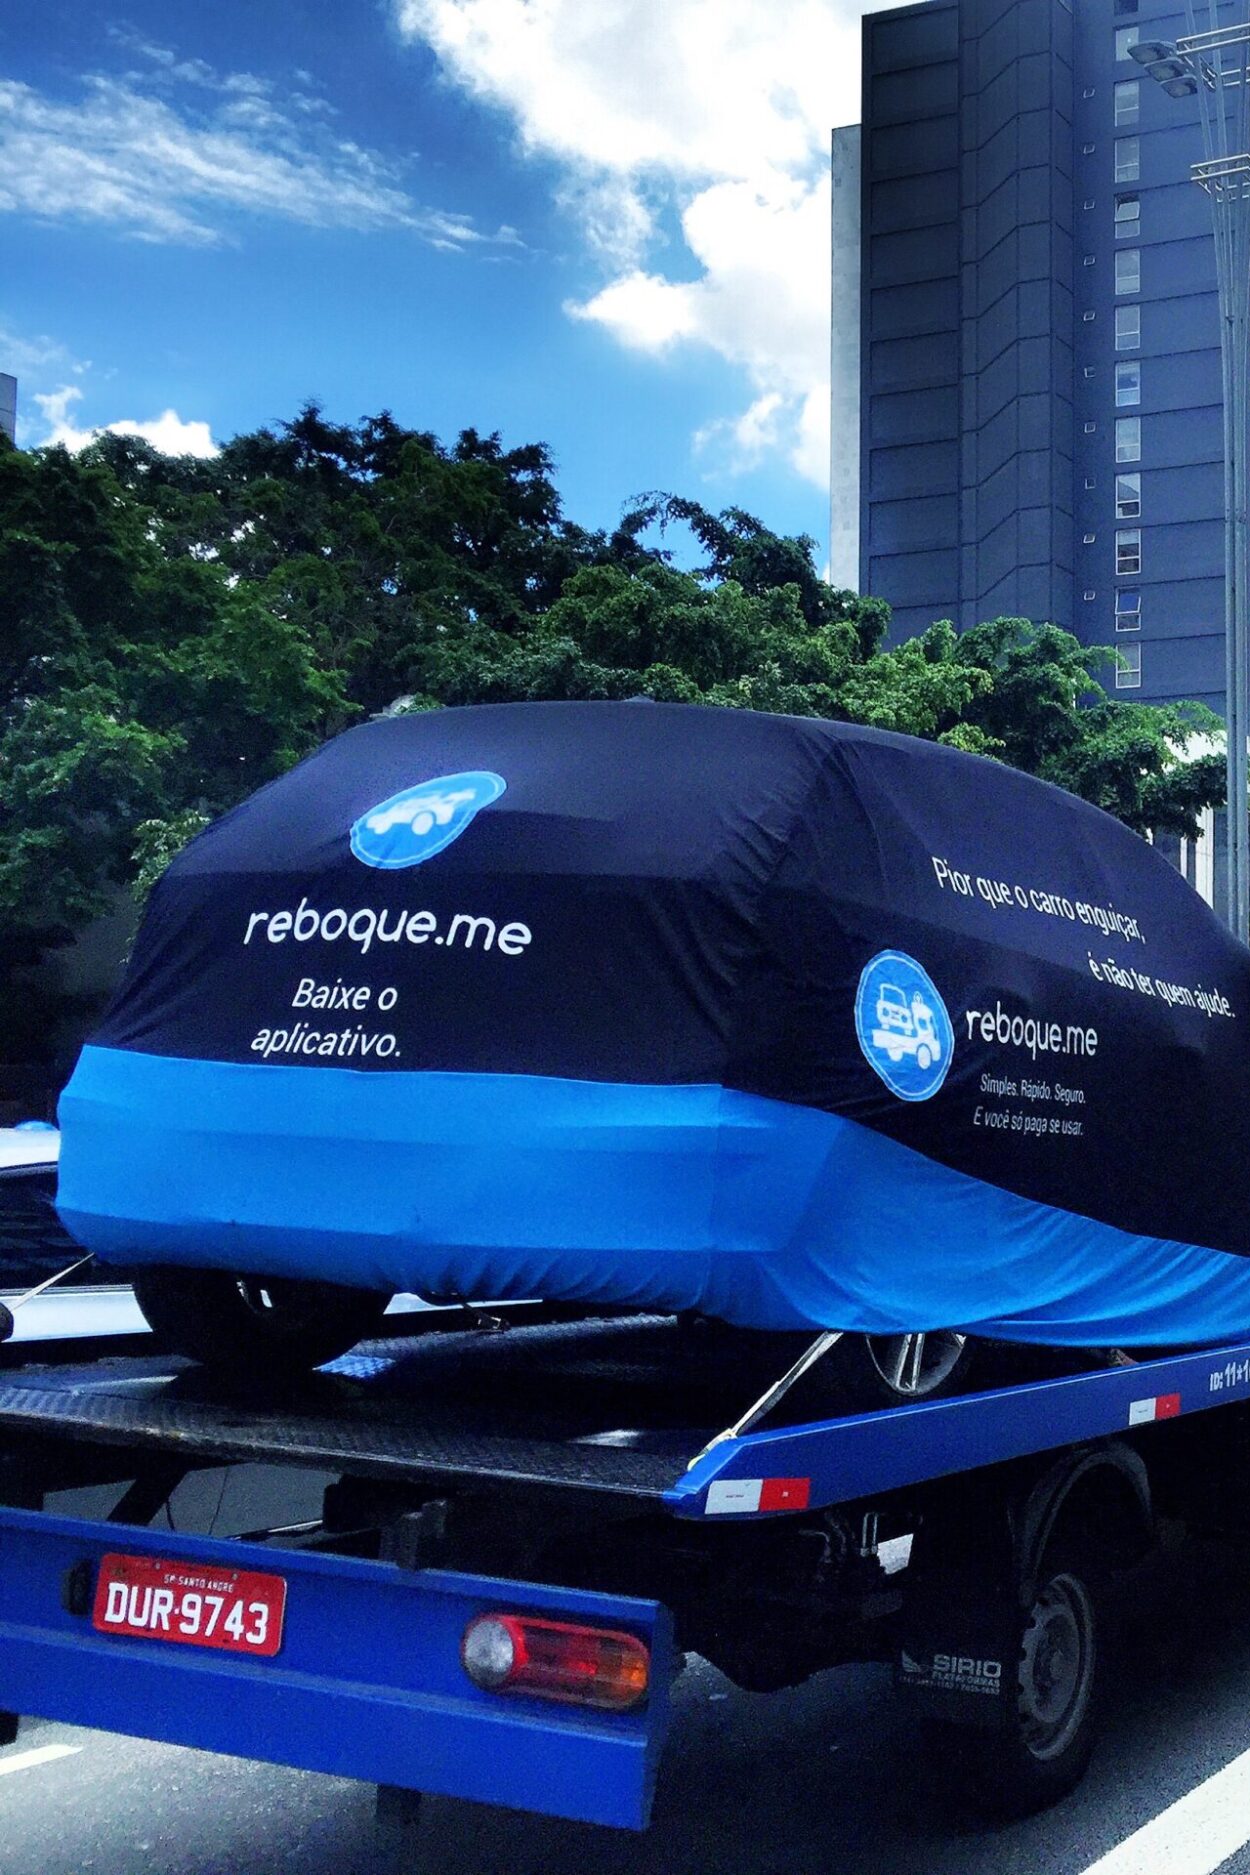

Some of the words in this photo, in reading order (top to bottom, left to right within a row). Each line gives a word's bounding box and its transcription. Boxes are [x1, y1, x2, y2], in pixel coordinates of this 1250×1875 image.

[931, 856, 974, 897] Pior
[976, 877, 1014, 909] que
[1014, 886, 1029, 909] o
[1029, 888, 1075, 921] carro
[1075, 901, 1146, 945] enguiçar,
[243, 897, 533, 956] reboque.me
[291, 977, 370, 1011] Baixe
[377, 984, 398, 1011] o
[1100, 957, 1134, 990] não
[1130, 967, 1156, 996] ter
[1155, 979, 1196, 1008] quem
[1193, 984, 1236, 1018] ajude.
[250, 1023, 402, 1058] aplicativo.
[966, 1000, 1098, 1061] reboque.me
[980, 1073, 1019, 1097] Simples.
[1021, 1079, 1053, 1102] Rápido.
[1054, 1084, 1086, 1107] Seguro.
[973, 1106, 984, 1126] E
[984, 1109, 1010, 1129] você
[1011, 1110, 1023, 1130] só
[1023, 1117, 1048, 1137] paga
[1048, 1119, 1060, 1134] se
[1061, 1122, 1084, 1136] usar.
[1209, 1372, 1224, 1392] ID:
[932, 1654, 1002, 1678] SIRIO
